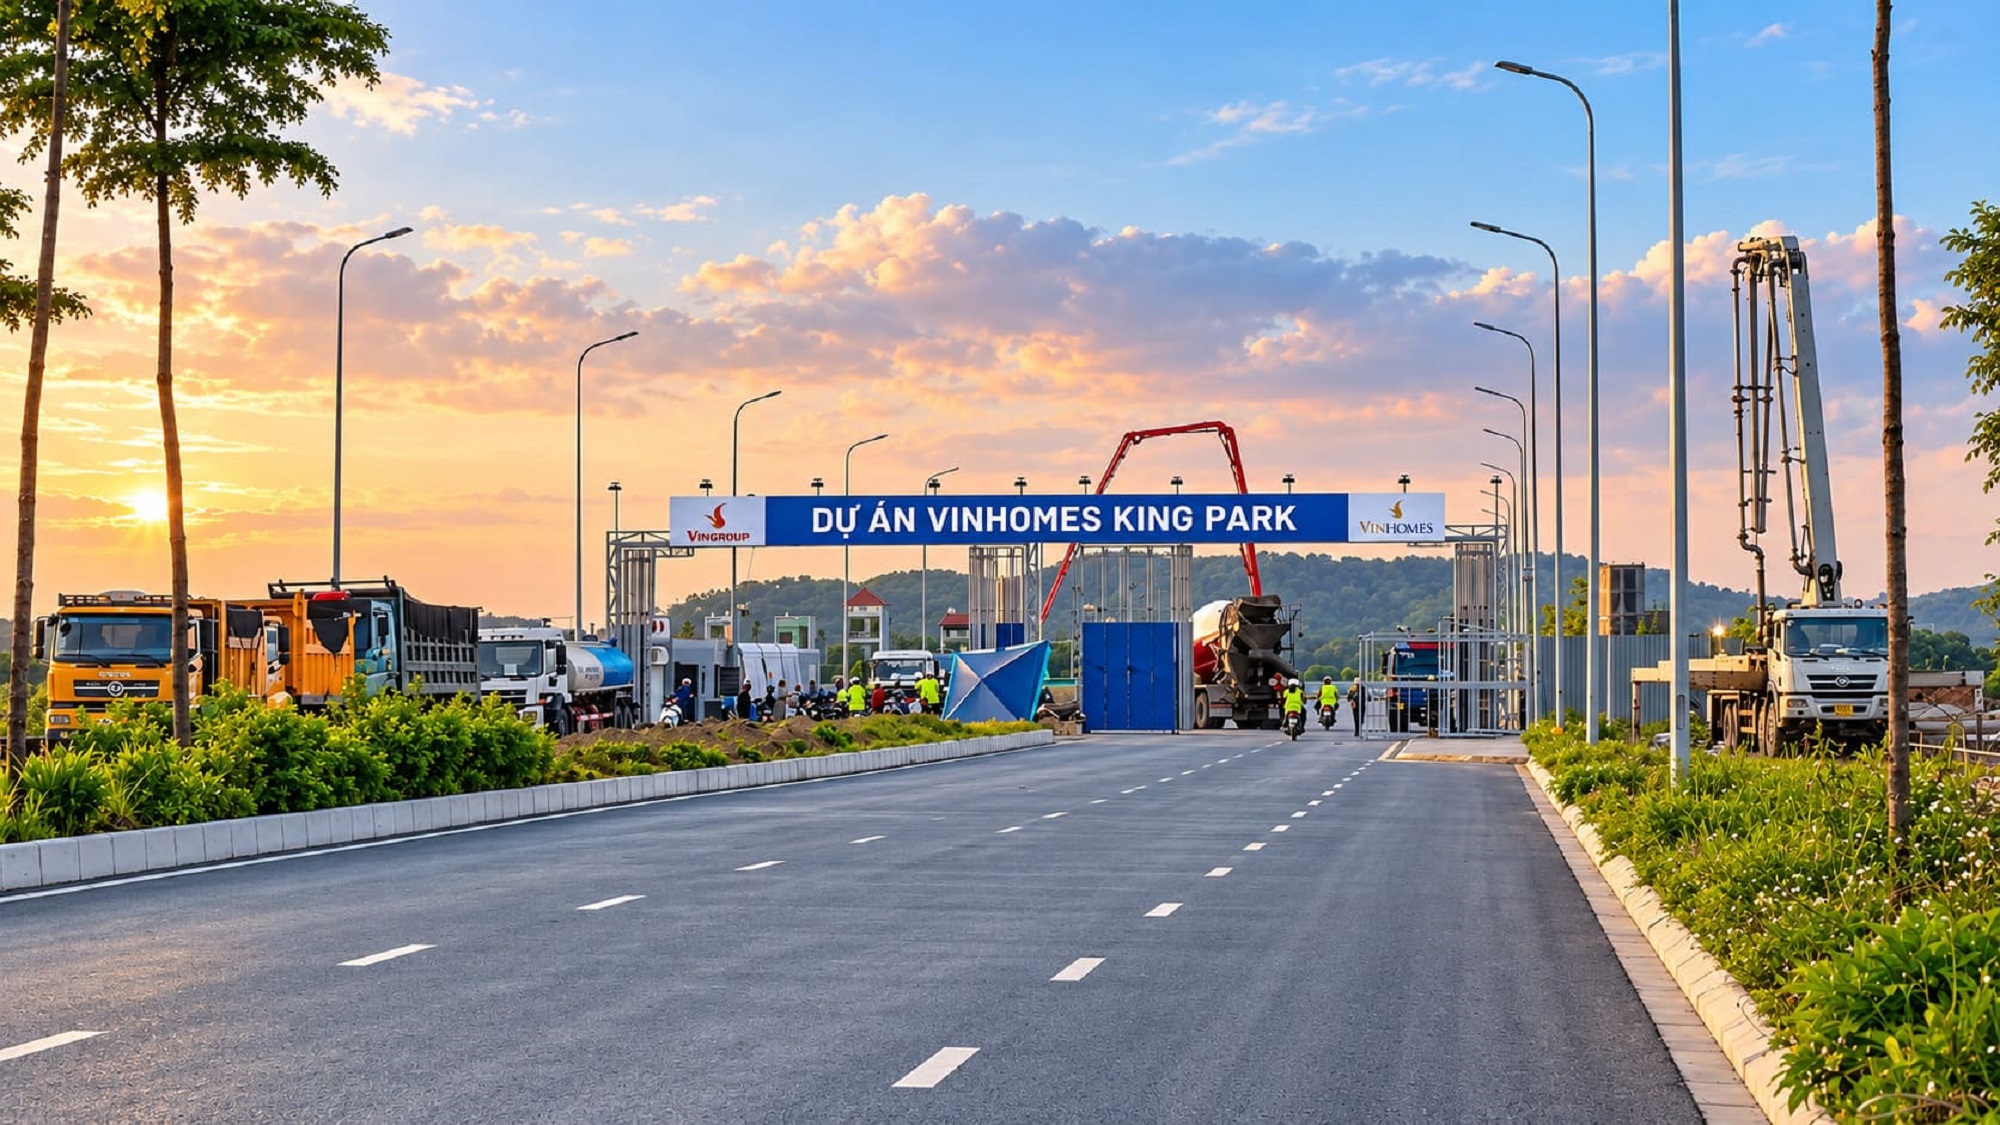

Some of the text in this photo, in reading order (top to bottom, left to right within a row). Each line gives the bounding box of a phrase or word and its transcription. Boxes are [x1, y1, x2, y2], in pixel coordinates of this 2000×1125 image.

[812, 500, 1298, 539] DỰ ÁN VINHOMES KING PARK
[1359, 520, 1434, 535] VINHOMES
[687, 530, 751, 543] VINGROUP
